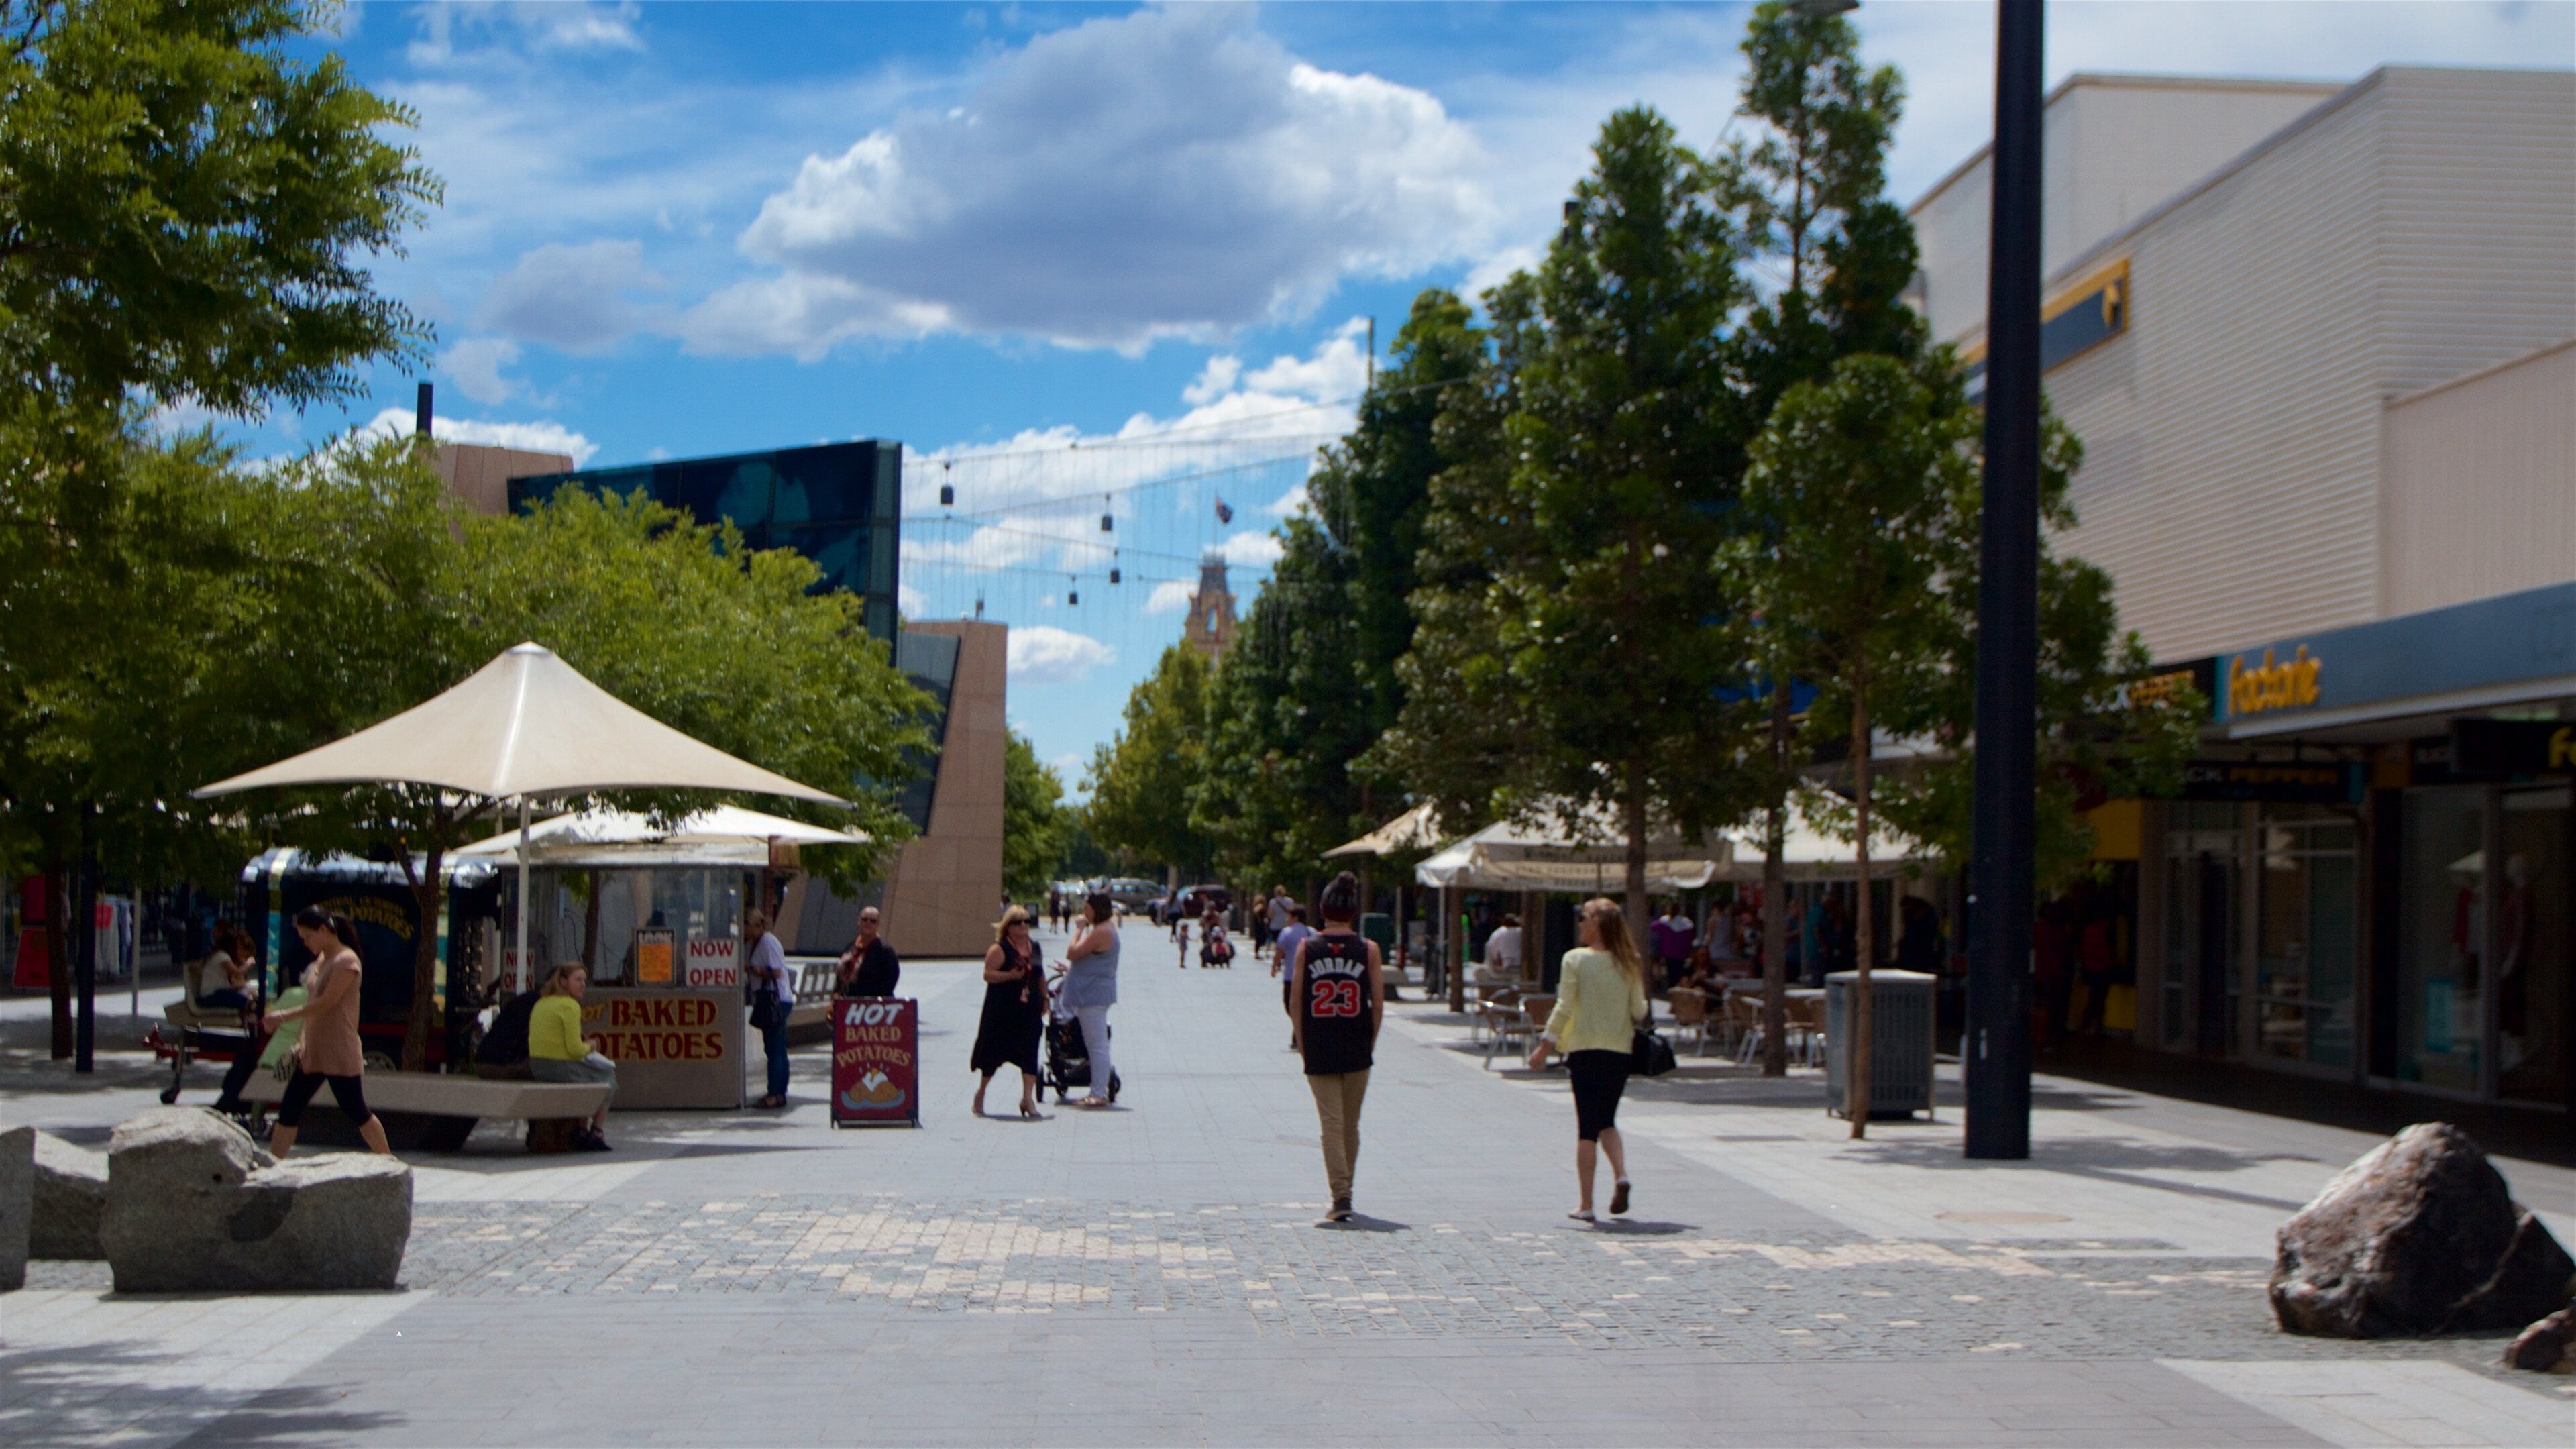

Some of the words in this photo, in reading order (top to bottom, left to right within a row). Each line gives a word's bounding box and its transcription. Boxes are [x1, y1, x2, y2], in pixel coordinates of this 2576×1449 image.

[506, 951, 533, 966] NW
[690, 941, 734, 957] NOW
[690, 968, 737, 986] OPEN
[1308, 957, 1366, 979] JORDAN
[1311, 979, 1360, 1017] 23
[610, 998, 717, 1027] BAKED
[844, 1002, 904, 1026] HOT
[845, 1026, 902, 1043] BAKED
[581, 1032, 724, 1061] OTATOES
[836, 1045, 912, 1068] POTATOES
